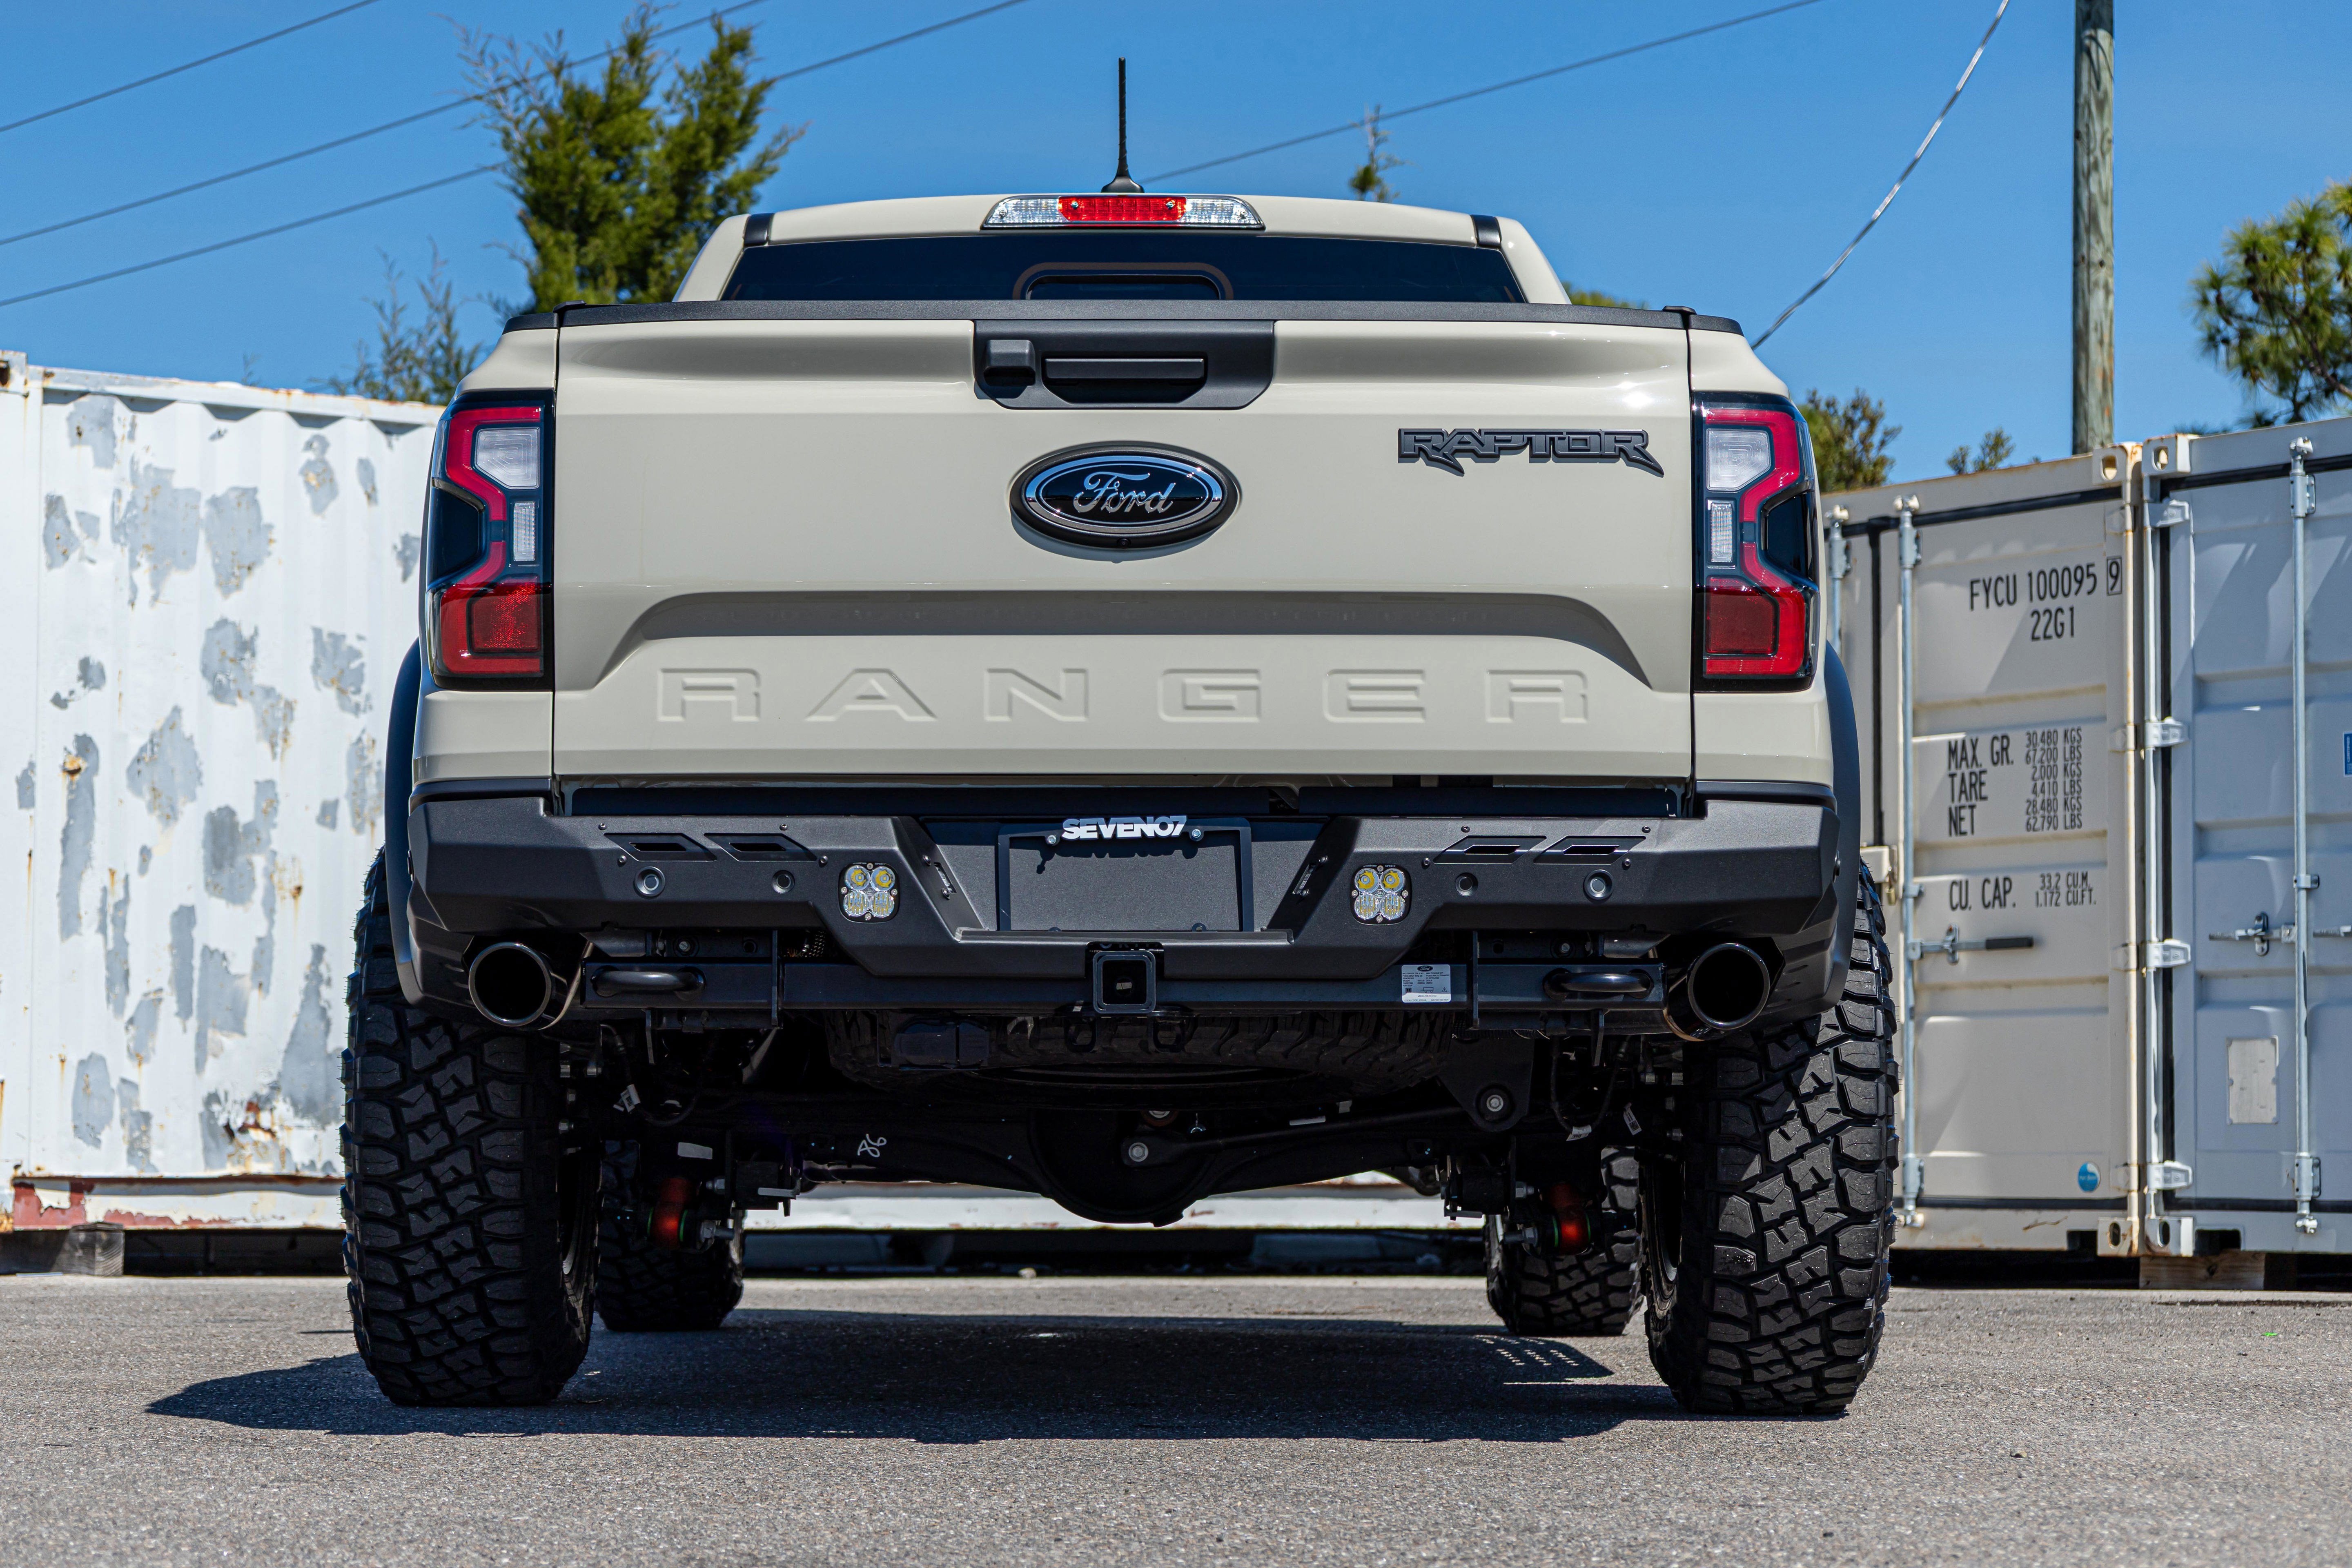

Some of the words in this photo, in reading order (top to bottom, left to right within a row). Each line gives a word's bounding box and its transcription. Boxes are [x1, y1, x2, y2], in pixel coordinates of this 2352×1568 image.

[1398, 428, 1664, 476] RAPTOR
[1073, 471, 1176, 513] Ford
[1969, 574, 2017, 612] FYCU
[2027, 561, 2098, 603] 100095
[2109, 560, 2120, 592] 9
[2031, 605, 2075, 642] 22G1
[657, 668, 1588, 723] RANGER
[2063, 726, 2082, 745] KGS
[1948, 738, 1982, 771] MAX.
[1991, 735, 2014, 766] GR.
[2063, 745, 2082, 762] LBS
[1949, 770, 1988, 804] TARE
[2063, 762, 2082, 779] KGS
[2063, 779, 2082, 796] LBS
[1949, 804, 1977, 837] NET
[2063, 796, 2082, 813] KGS
[2063, 813, 2082, 831] LBS
[1949, 879, 1972, 911] CU.
[1982, 876, 2016, 909] CAP.
